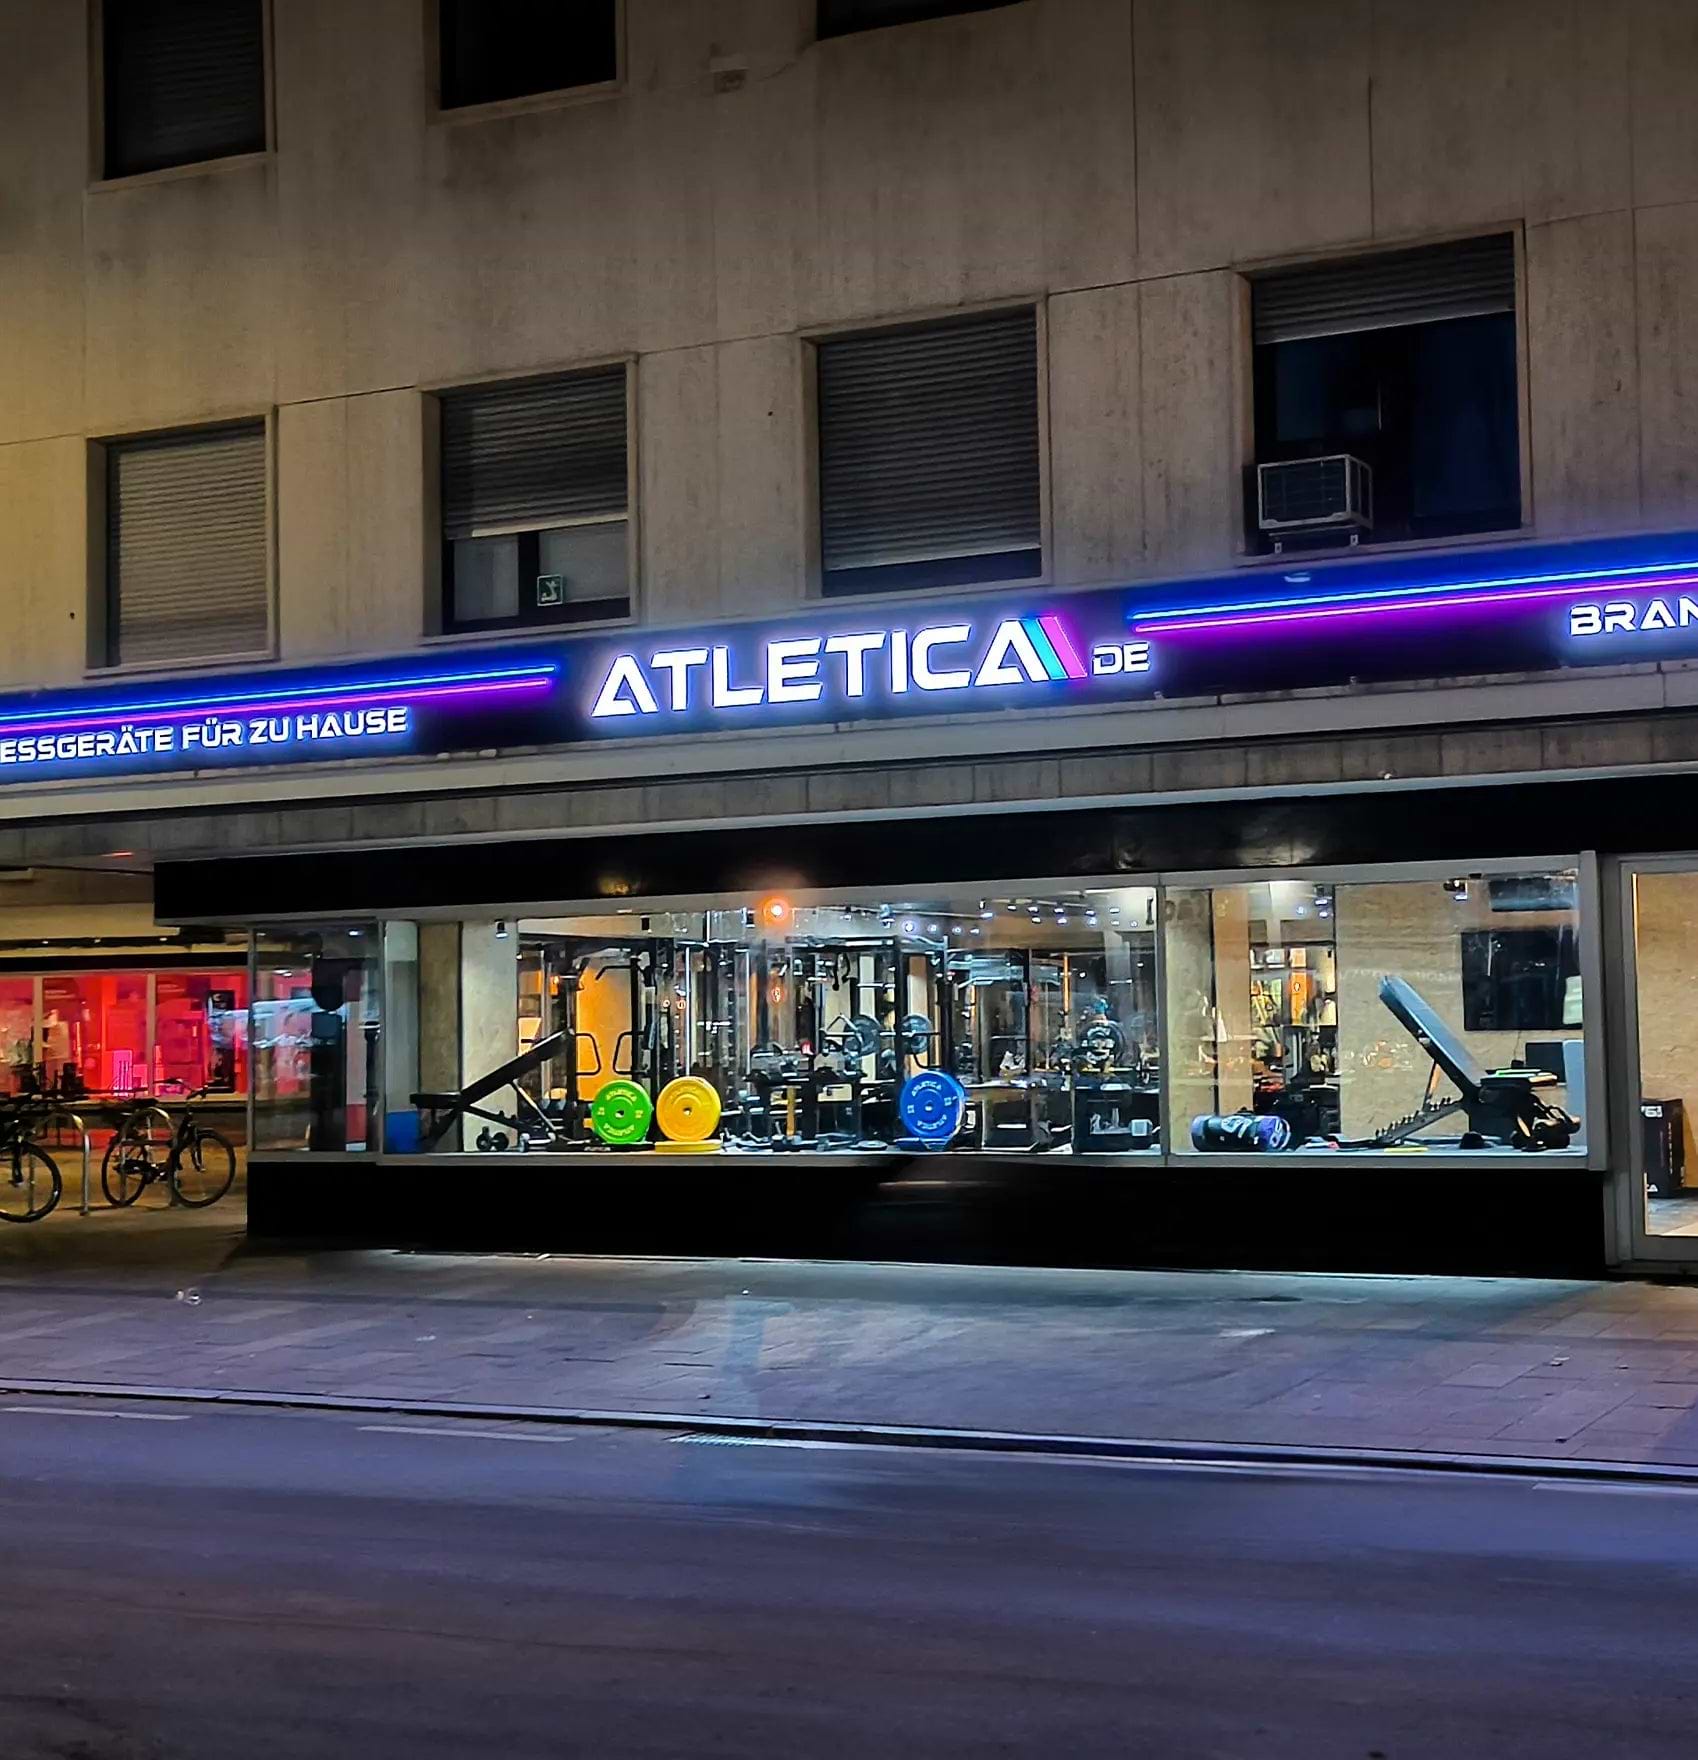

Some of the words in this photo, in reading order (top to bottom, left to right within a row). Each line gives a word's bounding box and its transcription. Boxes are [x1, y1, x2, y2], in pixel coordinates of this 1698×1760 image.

[591, 619, 1052, 718] ATLETICA
[1092, 641, 1150, 675] DE
[0, 725, 174, 764] ESSGERÄTE
[181, 717, 243, 750] FÜR
[249, 716, 290, 744] ZU
[296, 706, 409, 740] HAUSE
